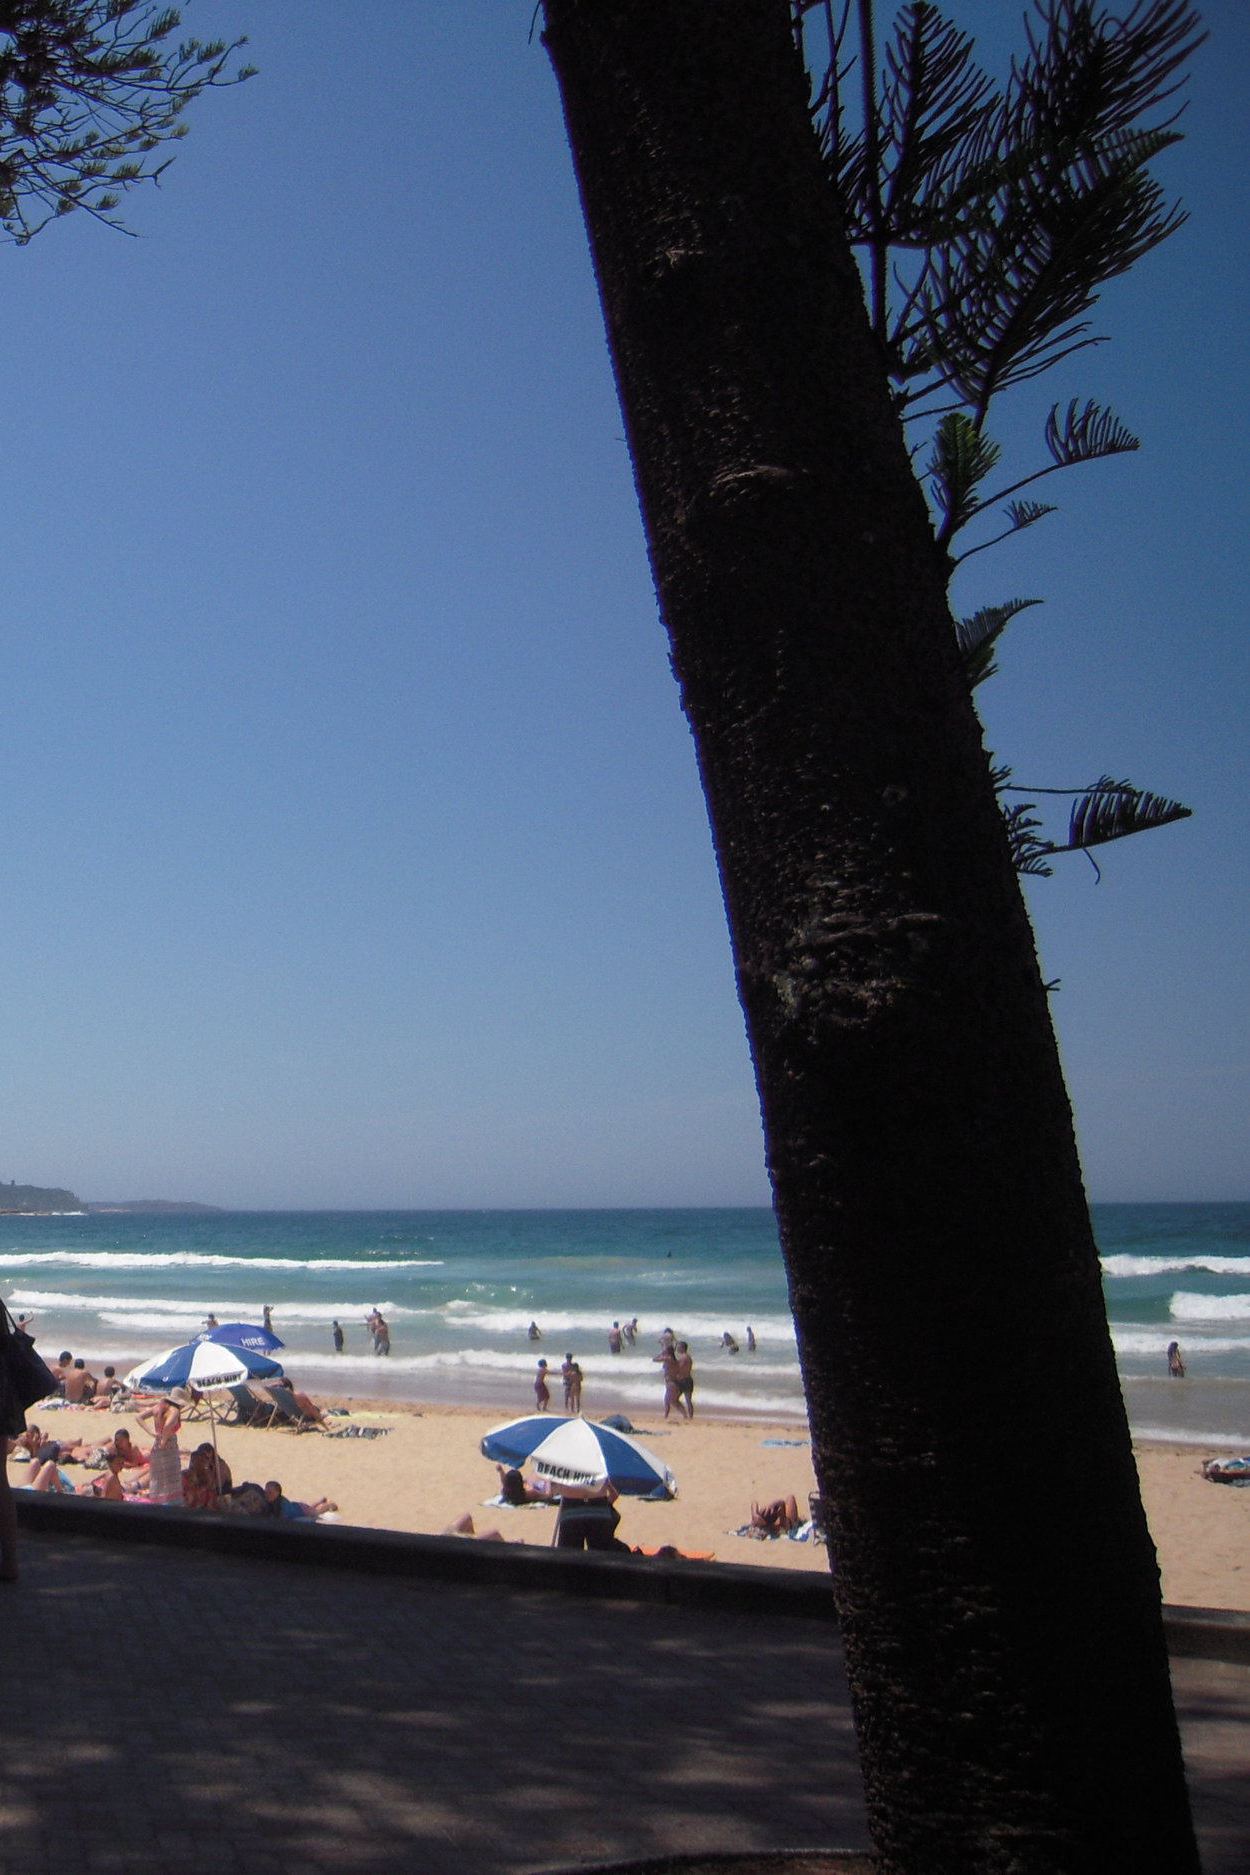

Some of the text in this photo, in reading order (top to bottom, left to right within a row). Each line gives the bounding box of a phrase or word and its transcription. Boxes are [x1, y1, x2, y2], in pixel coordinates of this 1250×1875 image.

[241, 1336, 265, 1347] HIRE
[197, 1376, 222, 1388] BEACH
[537, 1461, 596, 1487] BEACH HIRE
